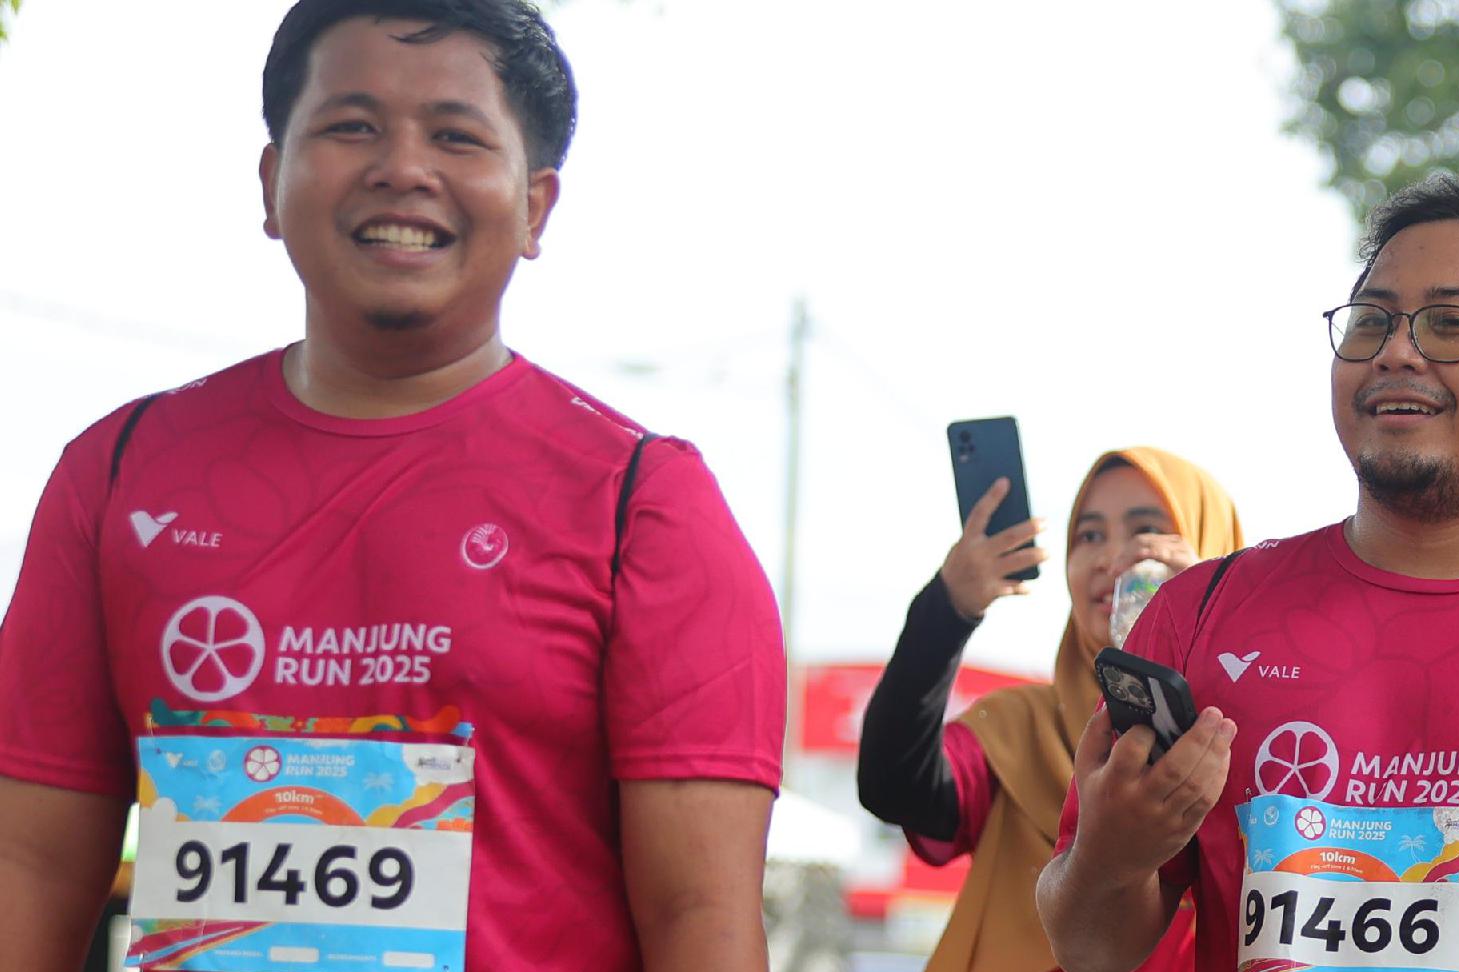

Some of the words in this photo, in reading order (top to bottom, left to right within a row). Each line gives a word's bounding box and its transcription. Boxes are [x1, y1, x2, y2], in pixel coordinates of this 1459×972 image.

[171, 528, 223, 548] VALE
[279, 623, 452, 655] MANJUNG
[275, 656, 351, 686] RUN
[358, 656, 431, 685] 2025
[1258, 665, 1301, 679] VALE
[286, 753, 355, 767] MANJUNG
[275, 790, 314, 804] 10km
[1346, 778, 1408, 805] RUN
[1330, 818, 1393, 831] MANJUNG
[1329, 829, 1356, 840] RUN
[1358, 830, 1386, 841] 2025
[1320, 851, 1356, 865] 10km
[175, 839, 415, 910] 91469
[1244, 889, 1440, 955] 91466
